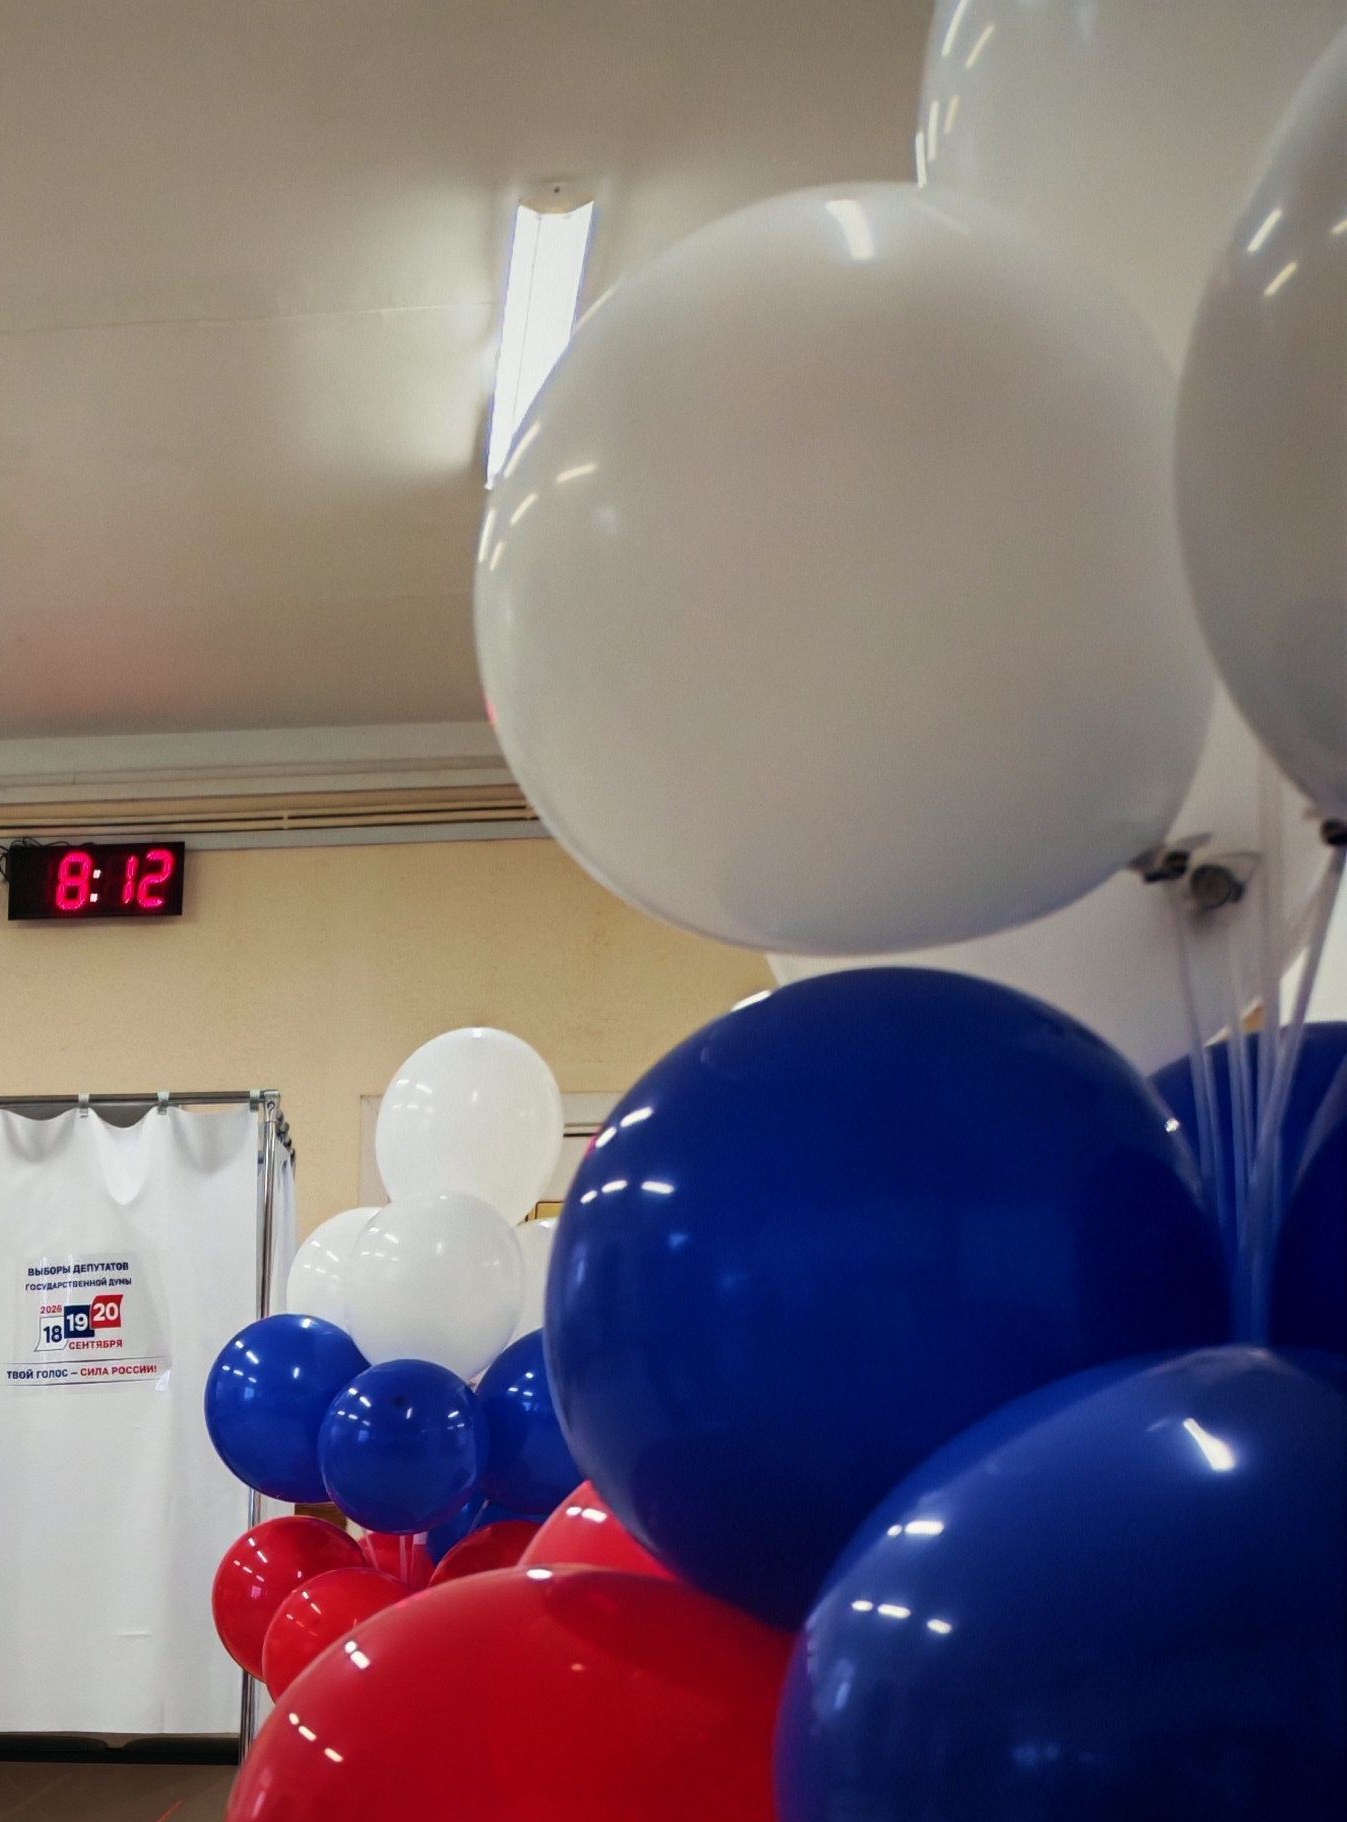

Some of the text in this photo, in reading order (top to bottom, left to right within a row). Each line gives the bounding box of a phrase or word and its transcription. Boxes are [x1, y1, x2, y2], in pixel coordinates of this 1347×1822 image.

[55, 849, 175, 911] 8:12
[27, 1261, 129, 1277] ВЫБОРЫ ДЕПУТАТОВ
[25, 1277, 132, 1291] ГОСУДАРСТВЕННОЙ ДУМЫ
[40, 1305, 63, 1314] 2026
[43, 1302, 119, 1344] 18 19 20
[68, 1339, 123, 1350] СЕНТЯБРЯ
[6, 1368, 34, 1380] ТВОЙ
[36, 1369, 68, 1379] ГОЛОС
[80, 1367, 109, 1377] СИЛА
[111, 1365, 157, 1375] РОССИИ!
